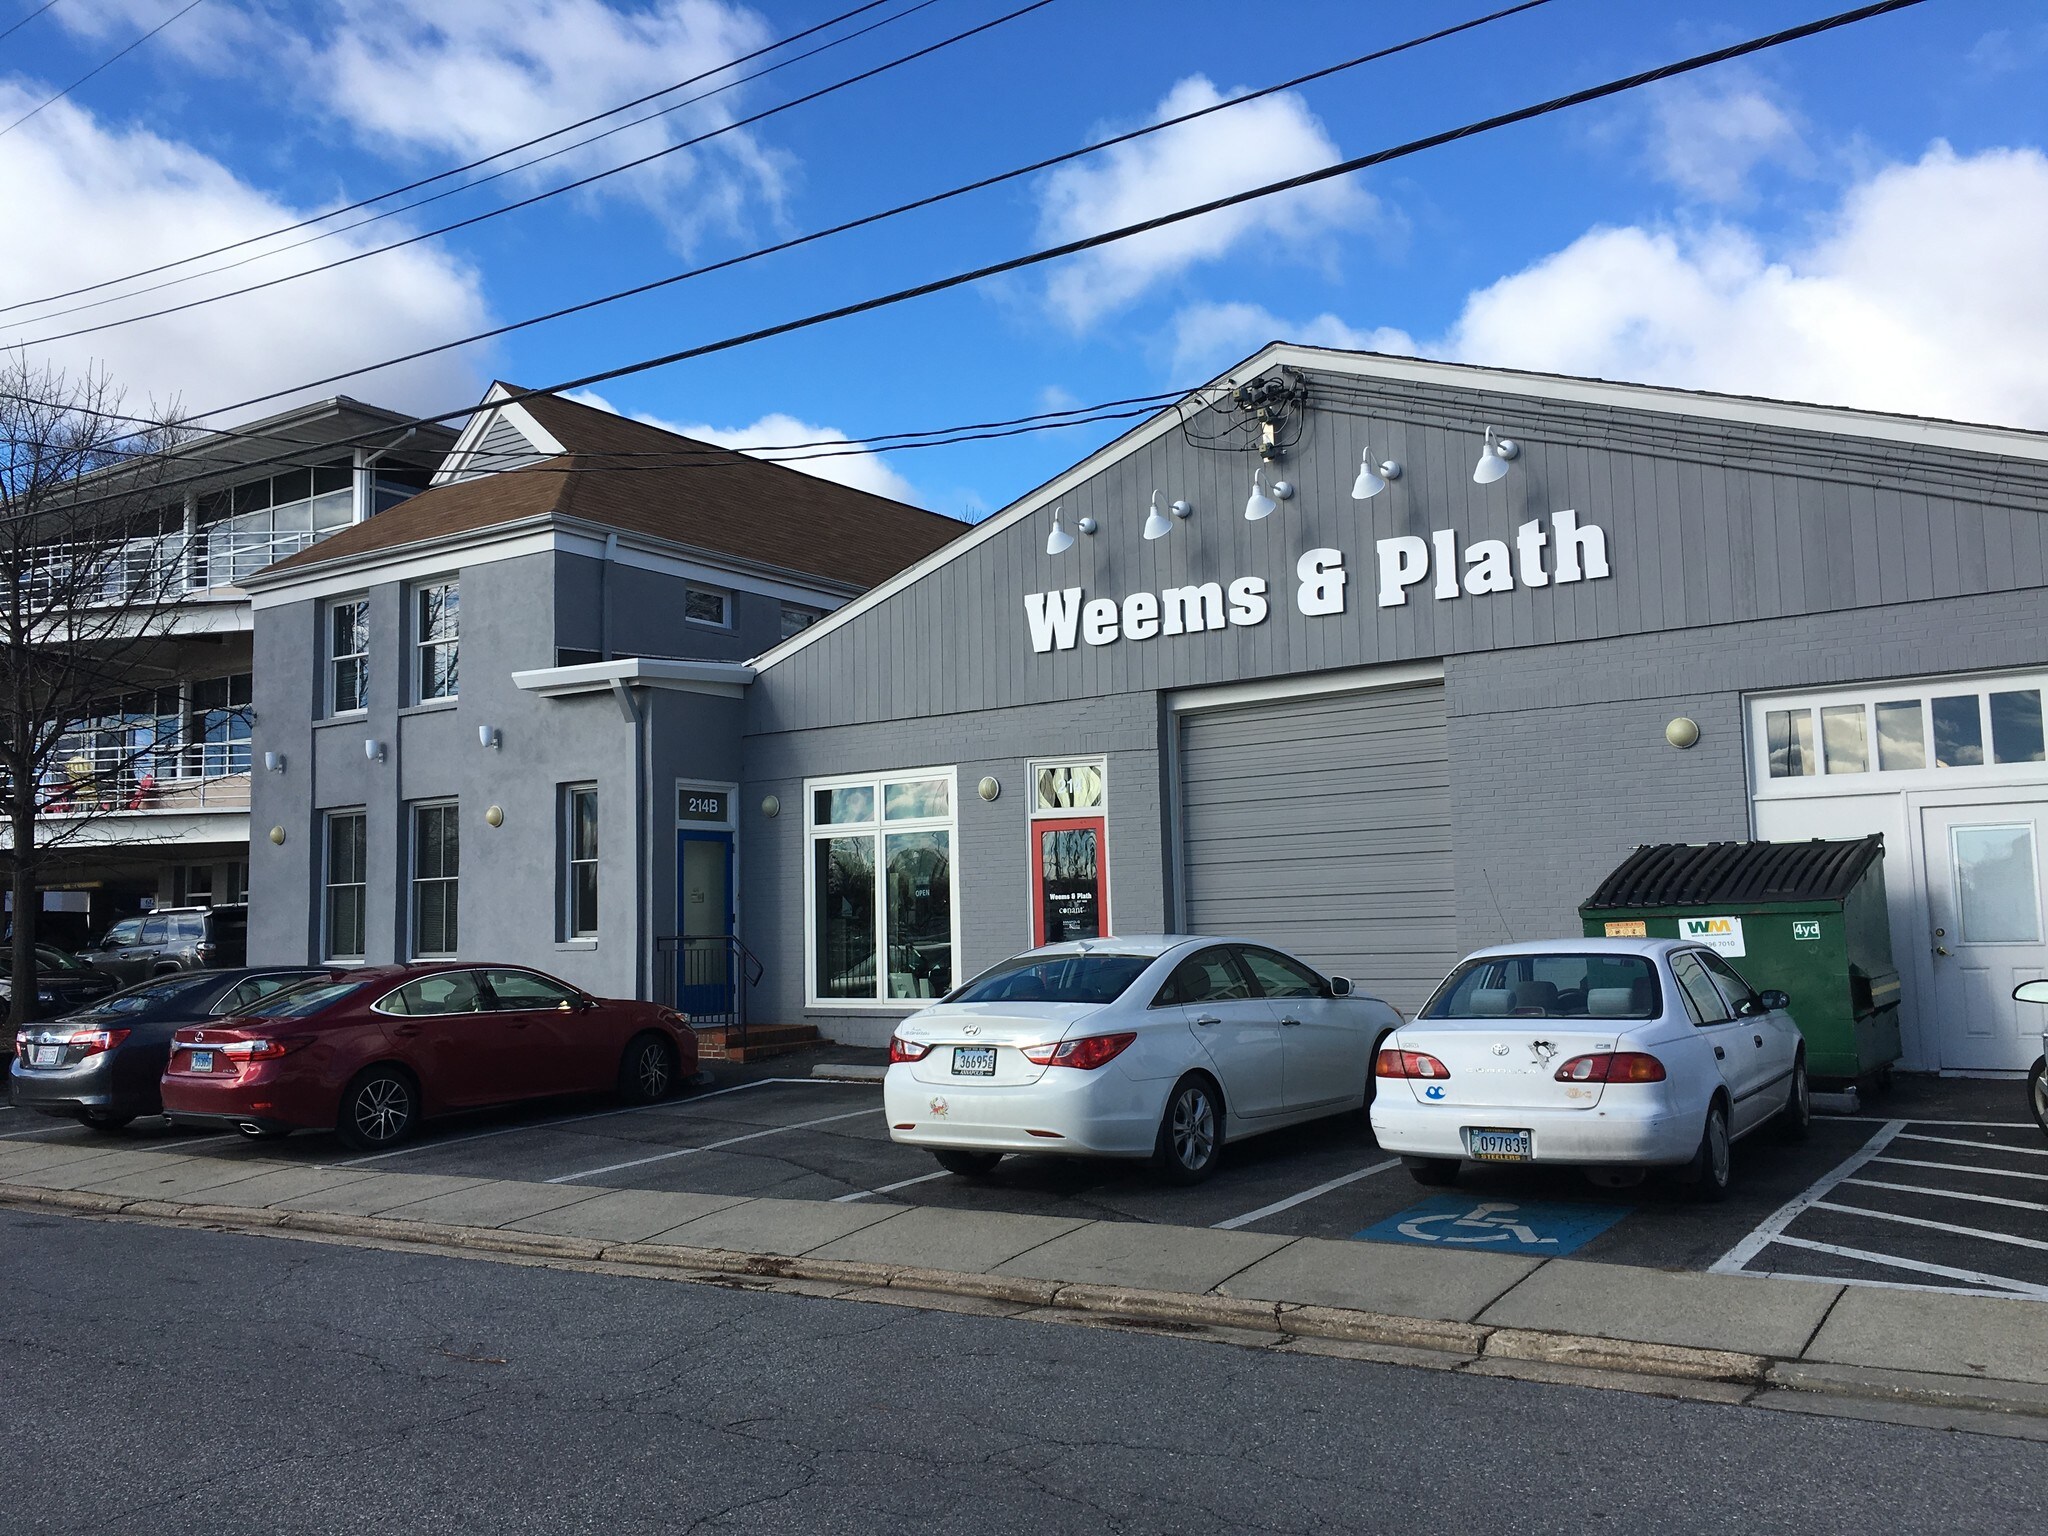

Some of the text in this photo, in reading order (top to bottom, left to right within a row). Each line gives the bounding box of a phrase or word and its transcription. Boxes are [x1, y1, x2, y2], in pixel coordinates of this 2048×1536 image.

[1024, 509, 1610, 653] Weems & Plath
[689, 798, 718, 812] 214B
[915, 889, 930, 897] OPEN
[1687, 919, 1732, 933] WM
[1795, 923, 1819, 937] 4yd
[960, 1055, 988, 1068] 36695
[1481, 1136, 1520, 1153] 09783
